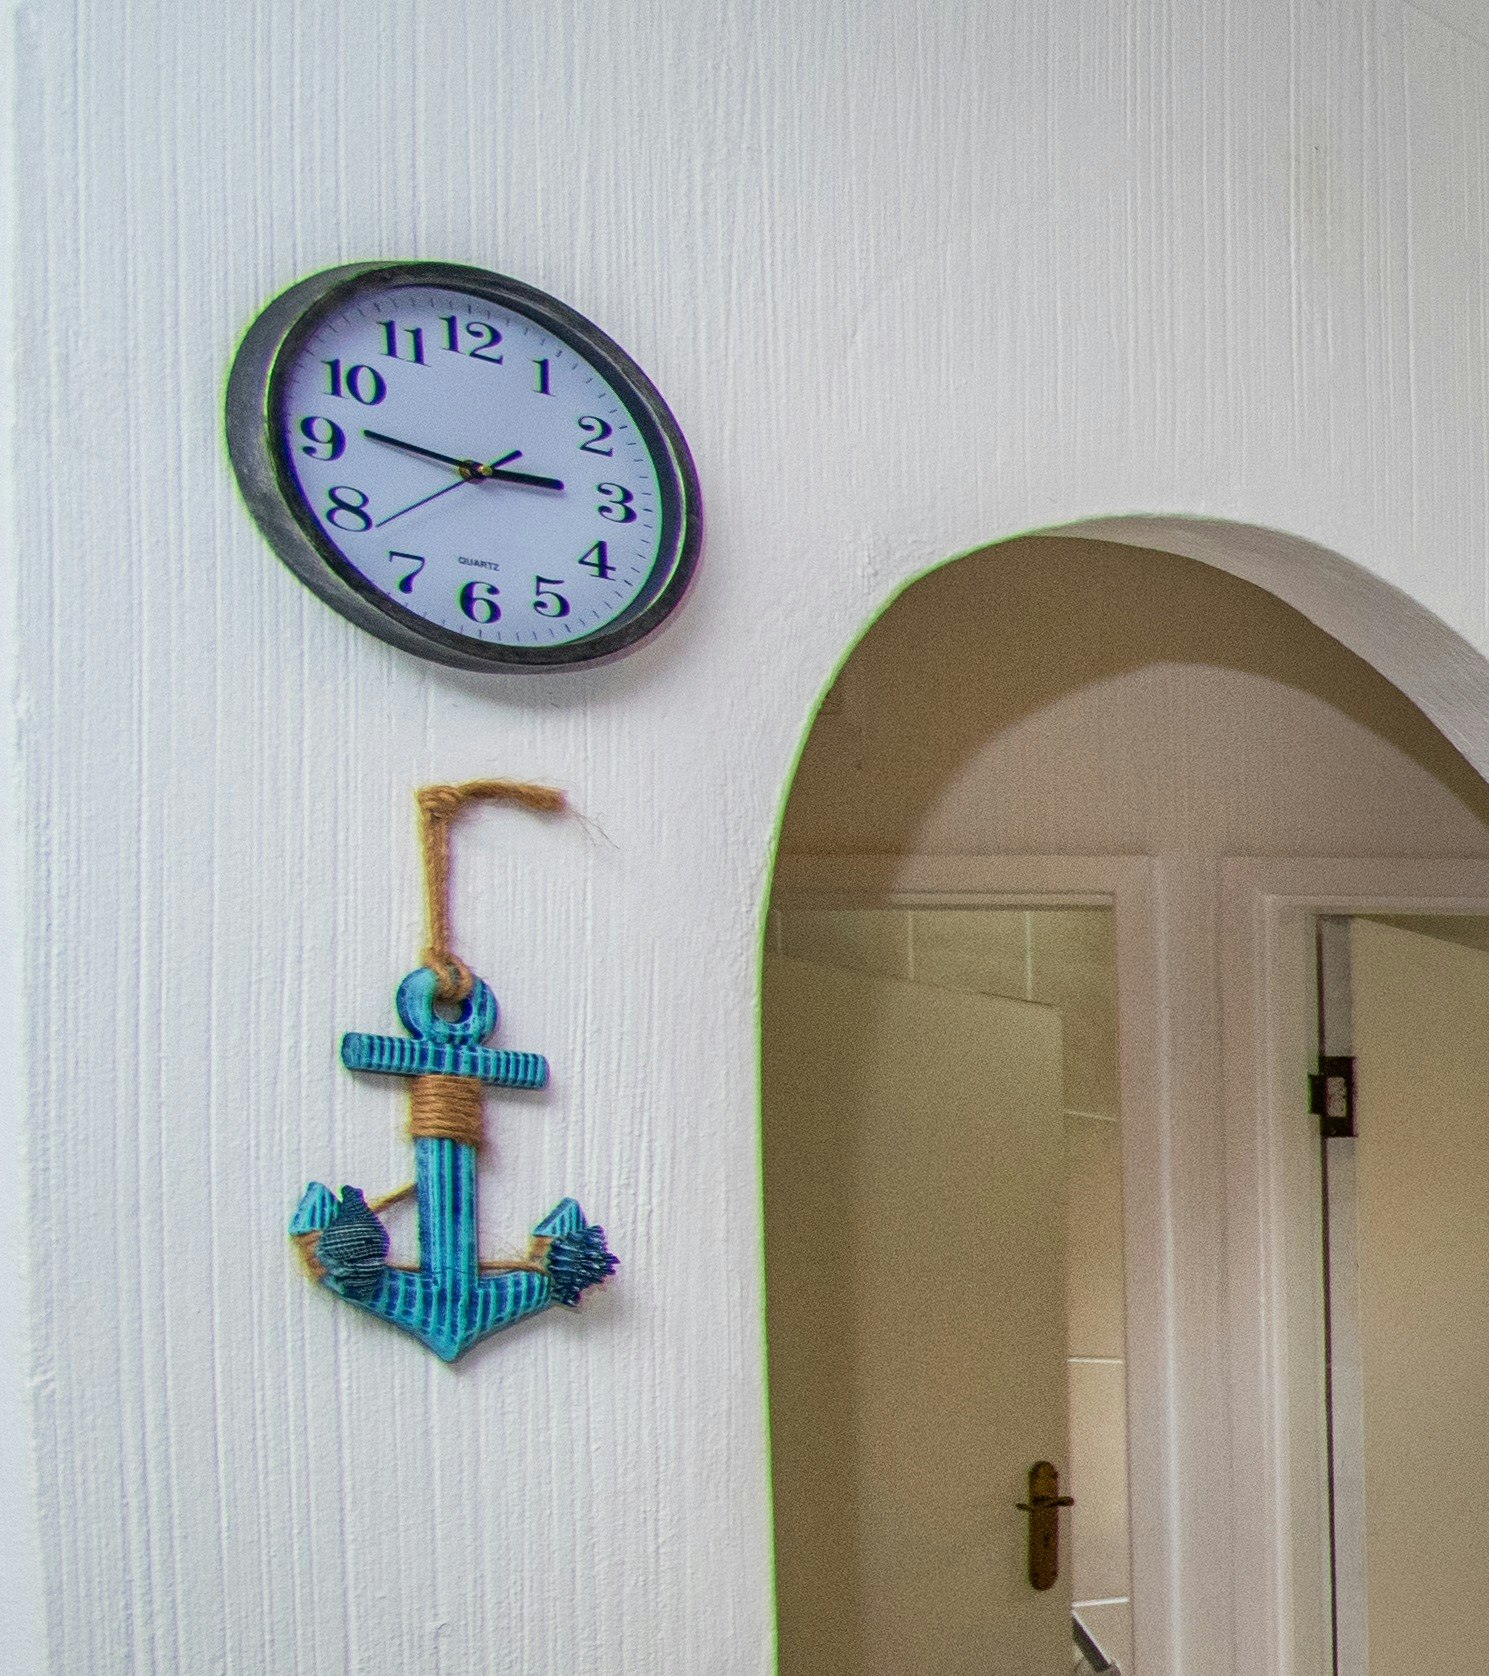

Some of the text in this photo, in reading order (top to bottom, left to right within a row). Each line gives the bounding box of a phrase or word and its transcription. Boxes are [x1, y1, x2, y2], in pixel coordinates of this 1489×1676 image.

[376, 319, 431, 367] 11
[439, 314, 504, 366] 12
[320, 357, 388, 406] 10
[532, 357, 557, 397] 1
[300, 415, 346, 462] 9
[577, 415, 613, 458] 2
[325, 485, 374, 533] 8
[597, 481, 638, 524] 3
[387, 549, 426, 595] 7
[458, 556, 501, 572] QUARTZ
[577, 540, 617, 581] 4
[458, 580, 501, 625] 6
[533, 574, 571, 618] 5
